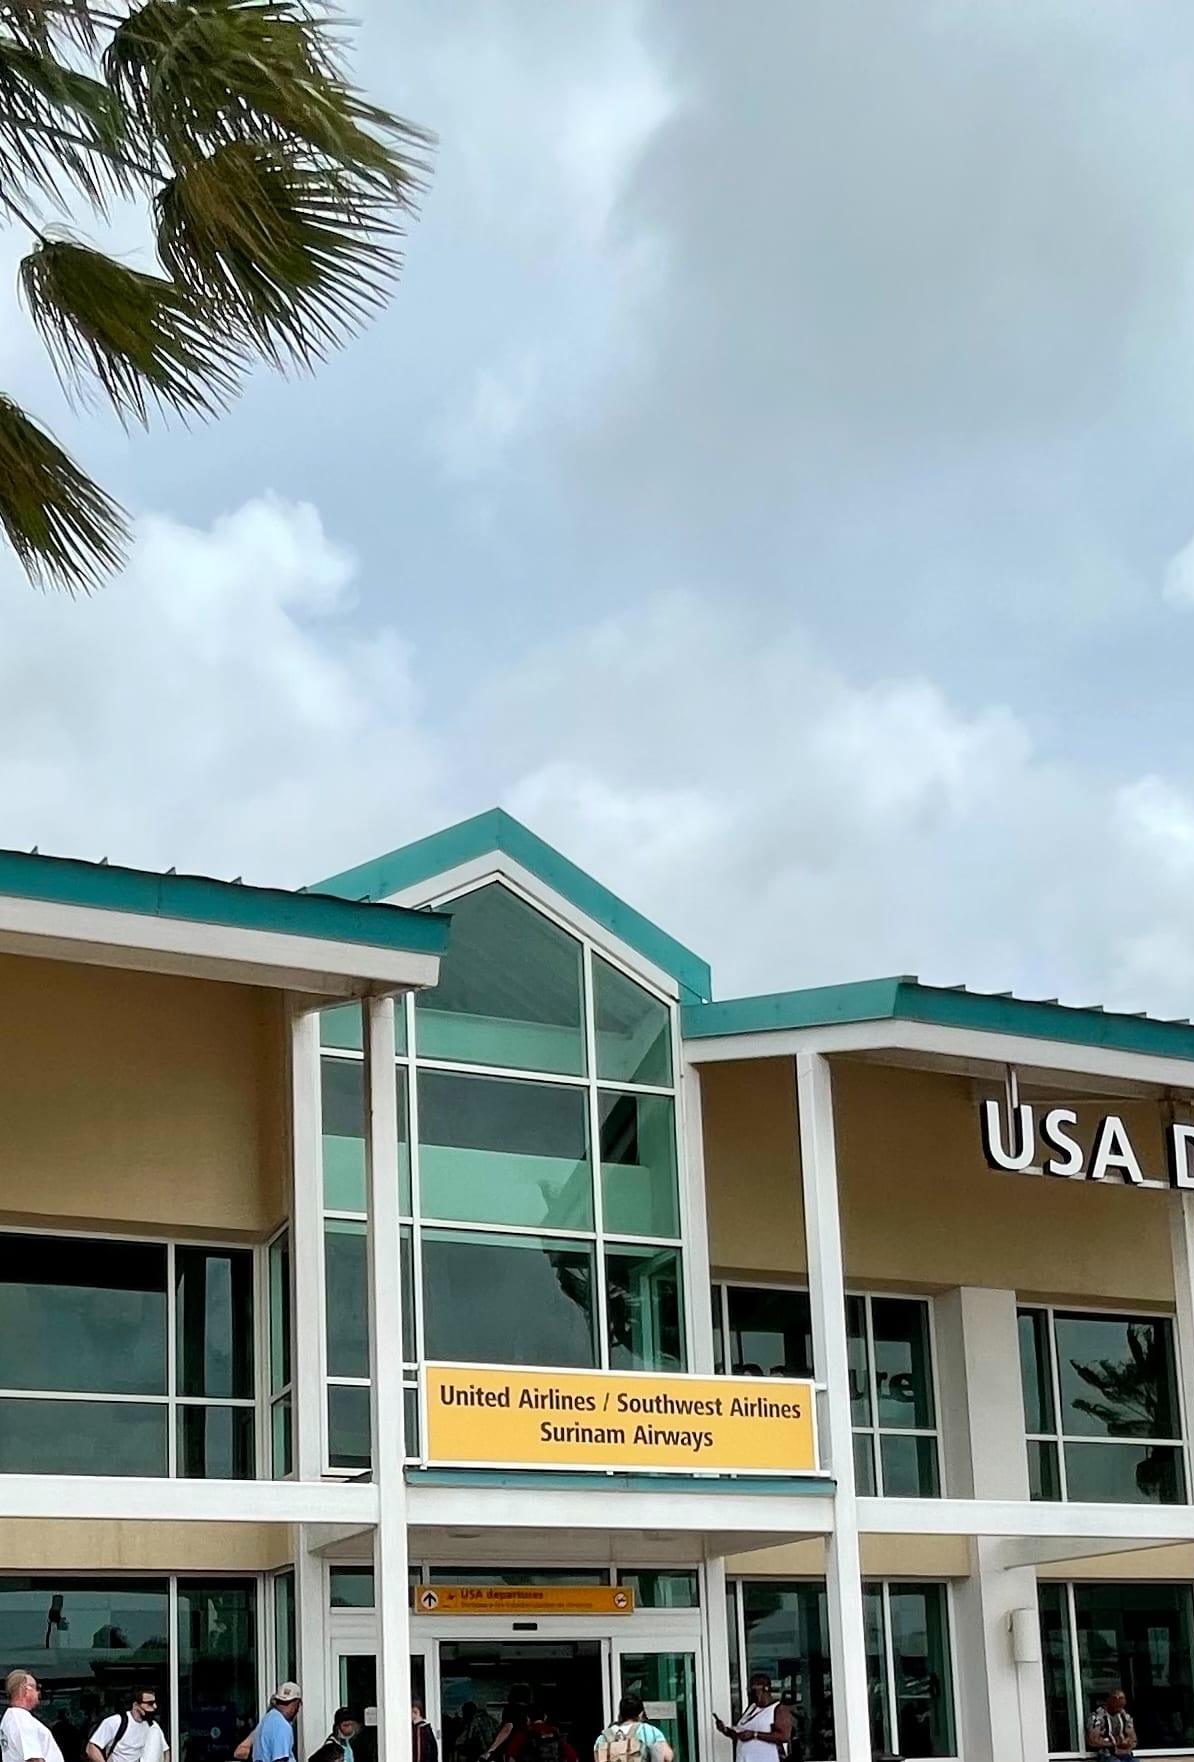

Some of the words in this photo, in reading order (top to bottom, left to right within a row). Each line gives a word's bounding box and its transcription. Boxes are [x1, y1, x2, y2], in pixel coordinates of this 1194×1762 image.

[981, 1099, 1143, 1184] USA
[440, 1384, 510, 1408] United
[518, 1387, 596, 1411] Airlines
[602, 1392, 610, 1412] /
[617, 1392, 723, 1416] Southwest
[730, 1396, 801, 1419] Airlines
[540, 1421, 625, 1444] Surinam
[633, 1424, 713, 1452] Airways
[461, 1589, 484, 1600] USA
